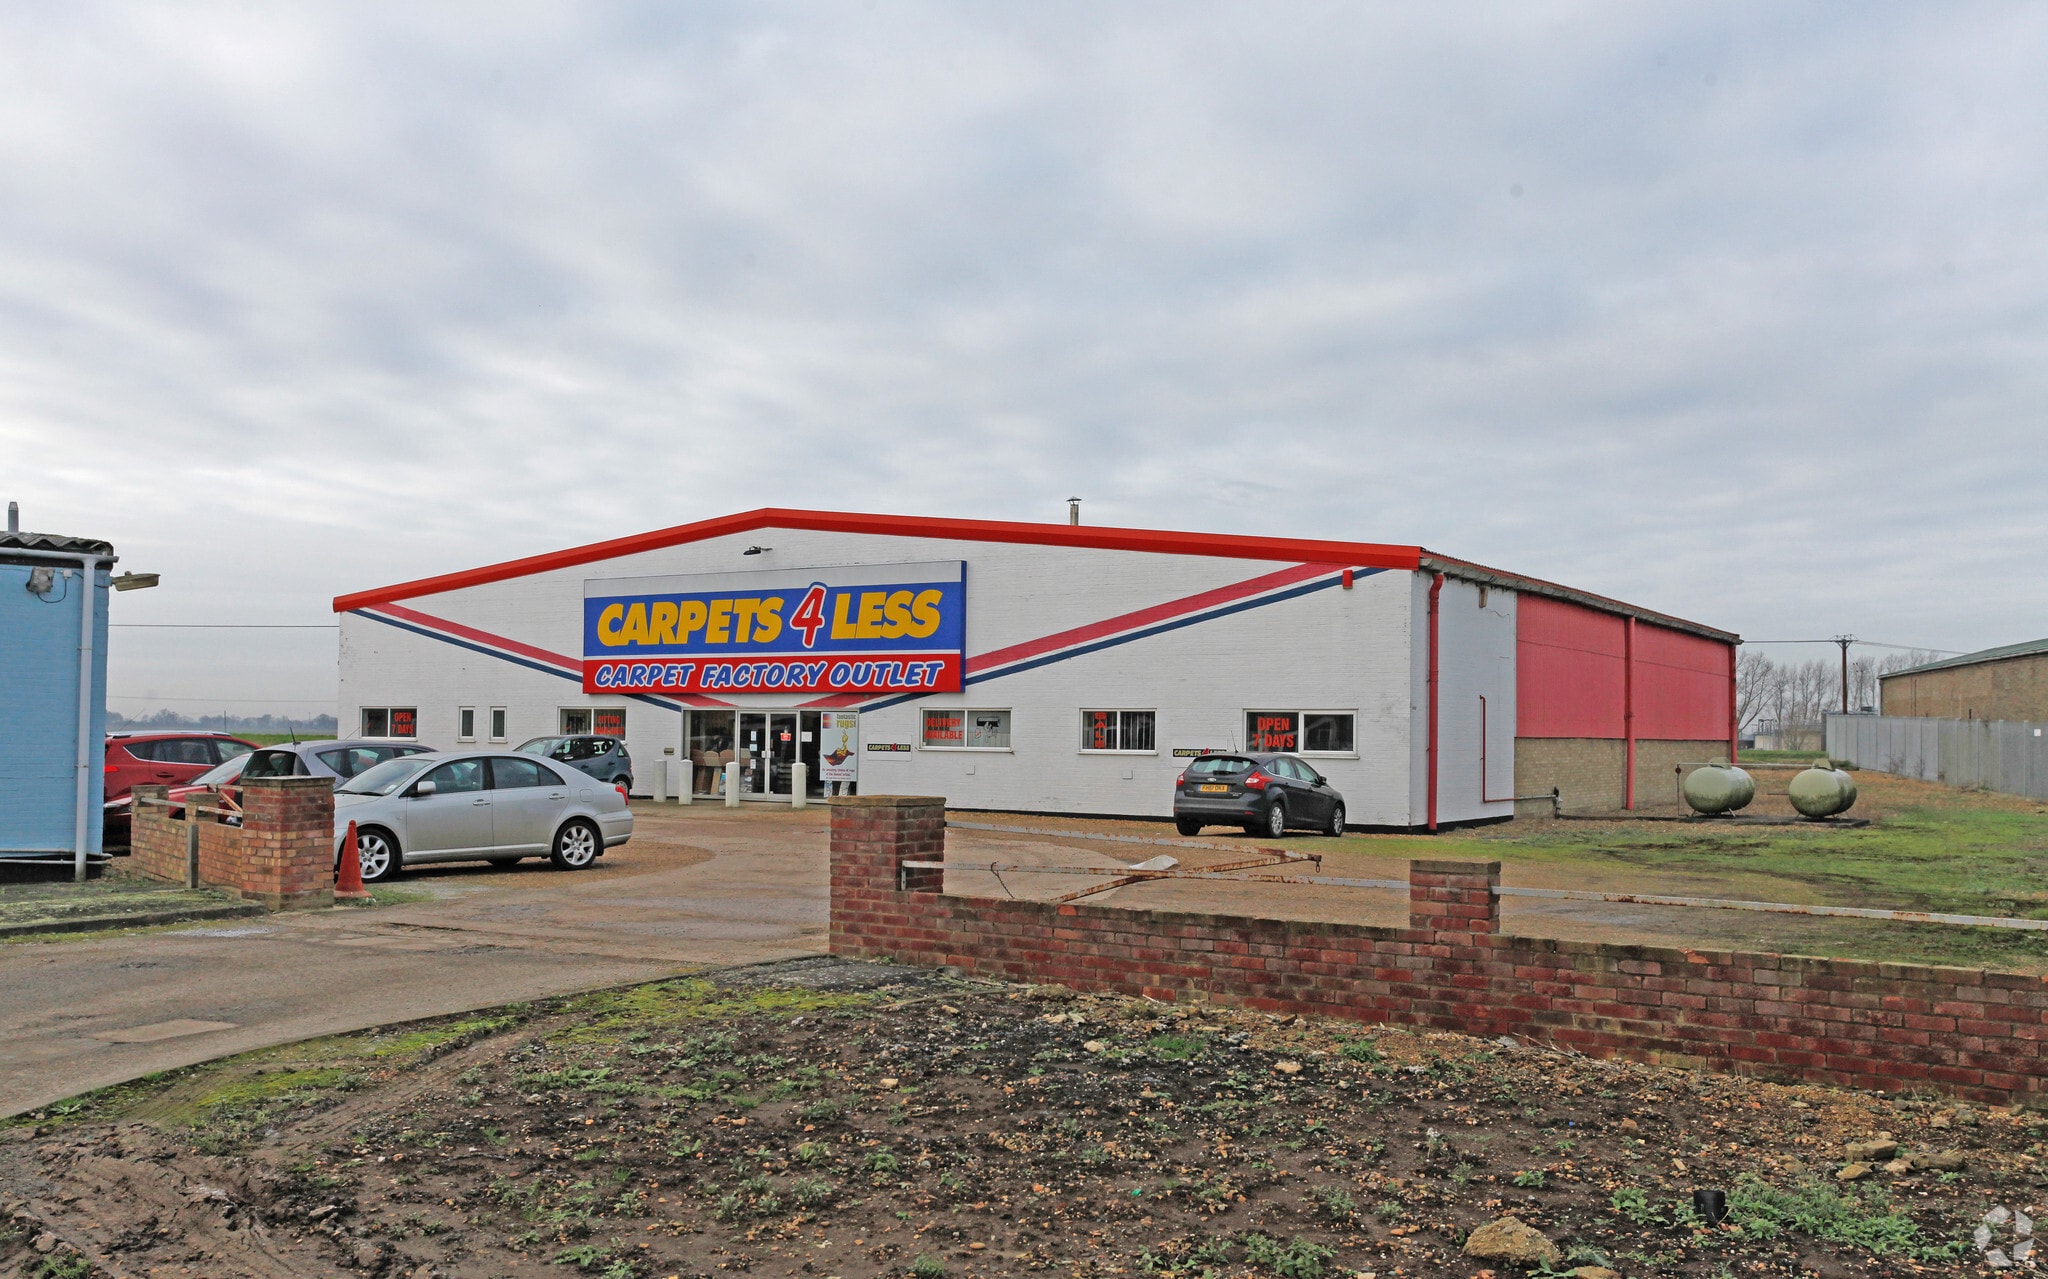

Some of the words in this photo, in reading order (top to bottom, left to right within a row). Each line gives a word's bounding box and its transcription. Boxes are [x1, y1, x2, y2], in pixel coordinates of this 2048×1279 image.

[597, 597, 784, 647] CARPETS
[790, 585, 827, 648] 4
[830, 589, 943, 639] LESS
[595, 662, 695, 688] CARPET
[700, 661, 827, 688] FACTORY
[829, 660, 945, 687] OUTLET
[394, 712, 412, 722] OPEN
[926, 717, 961, 727] DELIVERY
[391, 723, 397, 733] 7
[398, 723, 414, 734] DAYS
[1094, 711, 1107, 748] SALE
[1257, 717, 1290, 731] OPEN
[925, 730, 963, 740] AVAILABLE
[1252, 734, 1260, 747] 7
[1264, 734, 1295, 748] DAYS
[1174, 749, 1201, 757] CARPETS
